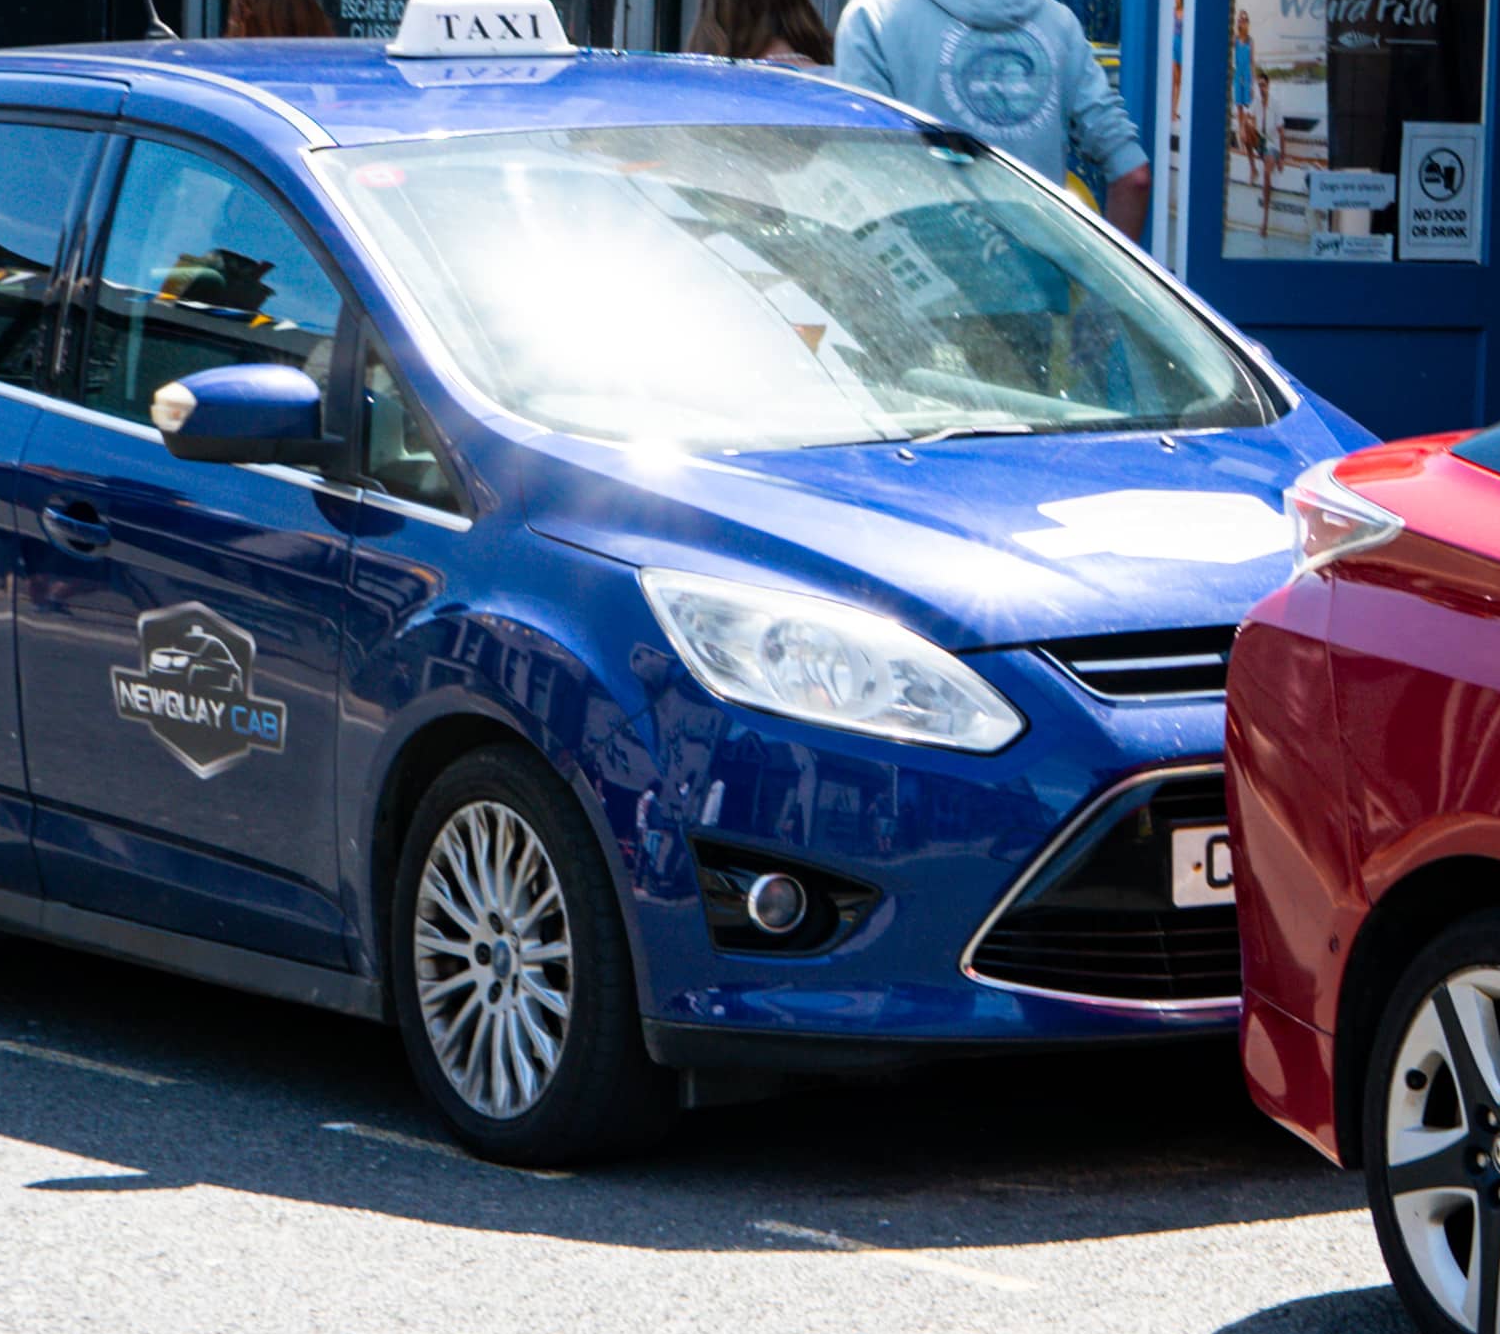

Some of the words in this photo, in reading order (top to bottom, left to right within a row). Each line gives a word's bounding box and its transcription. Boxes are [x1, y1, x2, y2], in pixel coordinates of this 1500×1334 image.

[436, 13, 545, 41] TAXI
[1412, 208, 1432, 221] NO
[1434, 208, 1467, 222] FOOD
[1411, 225, 1429, 238] OR
[1431, 226, 1468, 239] DRINK
[119, 680, 227, 730] NEWQUAY
[231, 705, 280, 742] CAB
